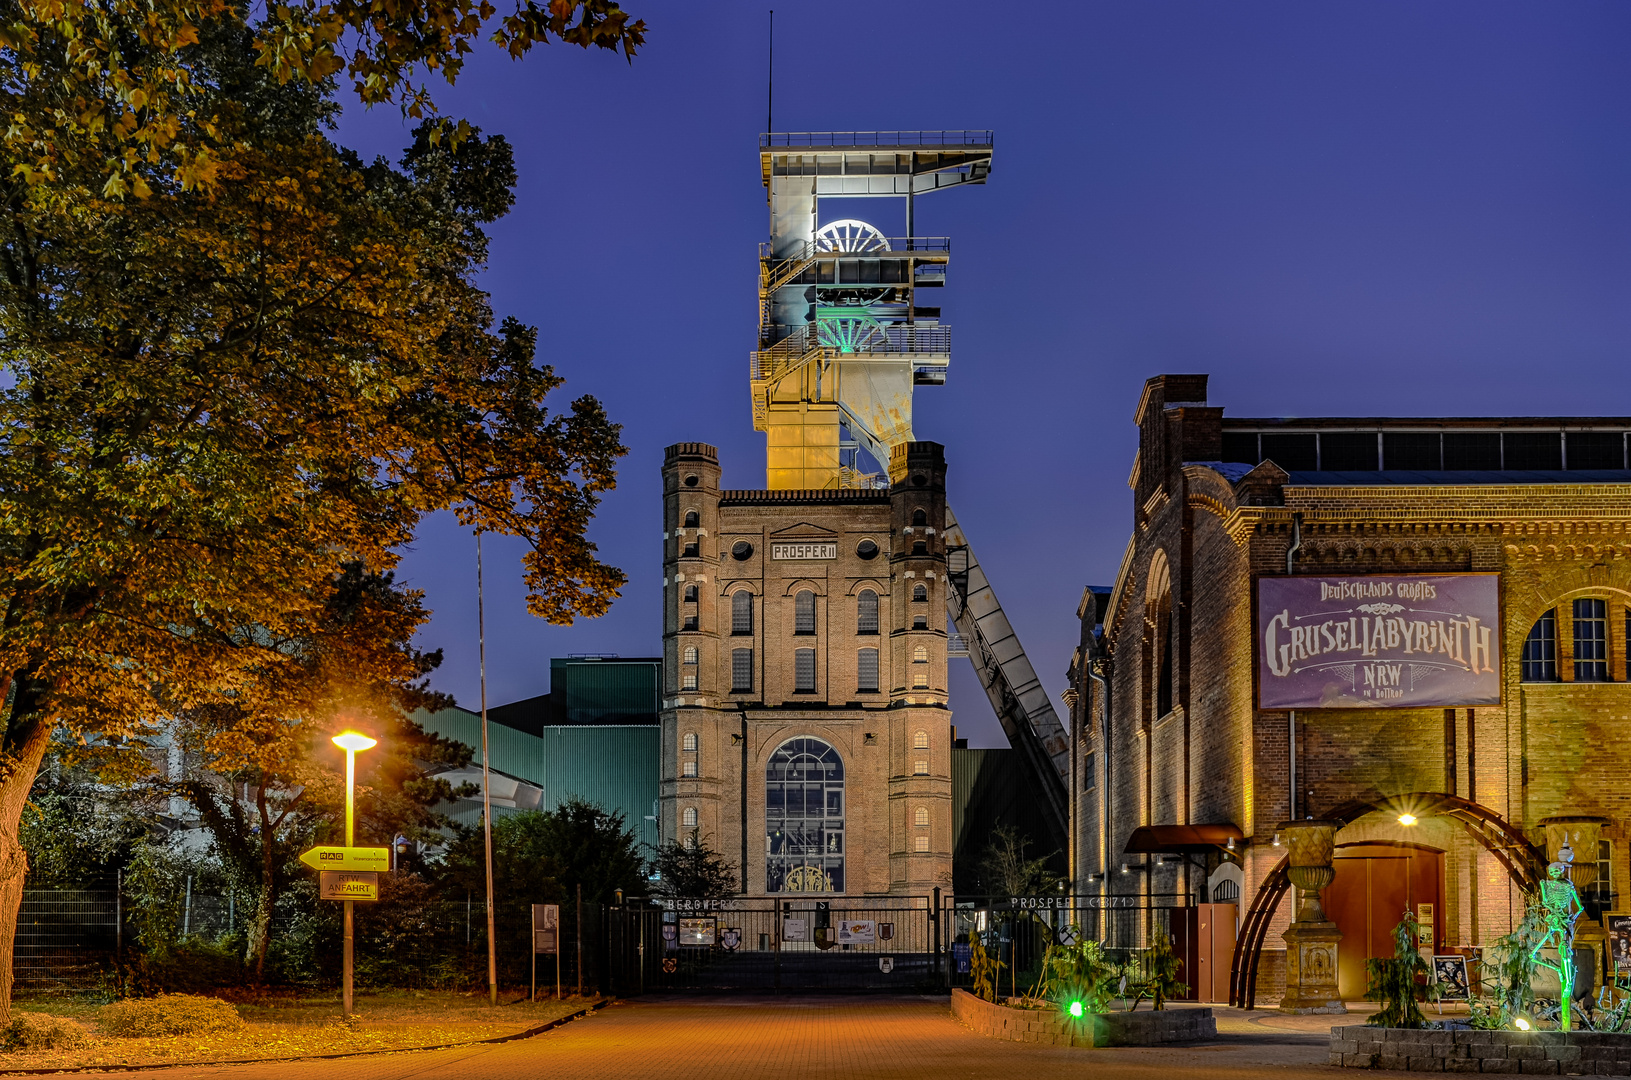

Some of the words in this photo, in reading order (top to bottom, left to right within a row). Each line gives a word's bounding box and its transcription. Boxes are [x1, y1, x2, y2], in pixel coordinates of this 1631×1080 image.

[774, 546, 827, 558] PROSPER
[1320, 581, 1393, 601] DEUTSCHLANDS
[1265, 609, 1494, 677] GRUSELLABYRINTH
[1363, 663, 1403, 688] NRW
[1375, 687, 1404, 699] BOTTROP
[328, 884, 370, 892] ANFAHRT
[668, 899, 737, 910] BERGWERK
